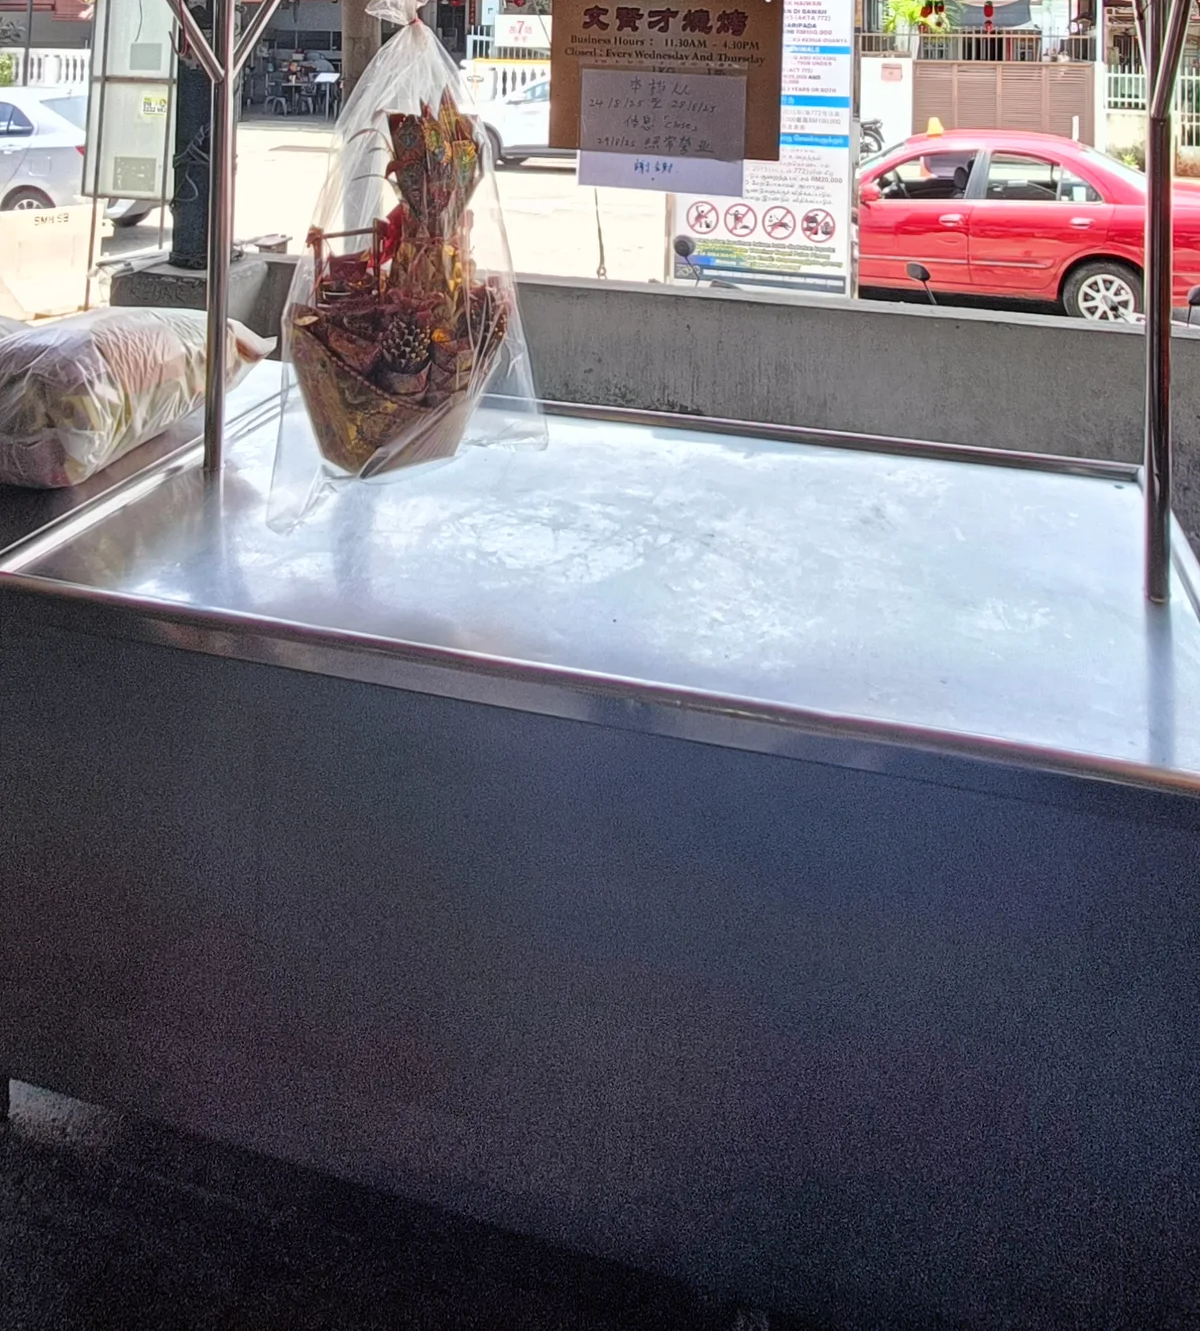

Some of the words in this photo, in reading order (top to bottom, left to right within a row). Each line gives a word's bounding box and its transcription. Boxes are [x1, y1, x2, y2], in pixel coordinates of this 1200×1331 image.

[581, 5, 749, 37] 文賢才燒烤
[570, 35, 611, 45] Business
[614, 36, 645, 46] Hours
[664, 38, 708, 49] 11.30AM
[722, 40, 760, 51] 4.30PM
[564, 47, 597, 57] Closed
[605, 49, 633, 59] Every
[634, 50, 690, 61] Wednesday
[691, 52, 714, 62] And
[716, 52, 766, 68] Thursday
